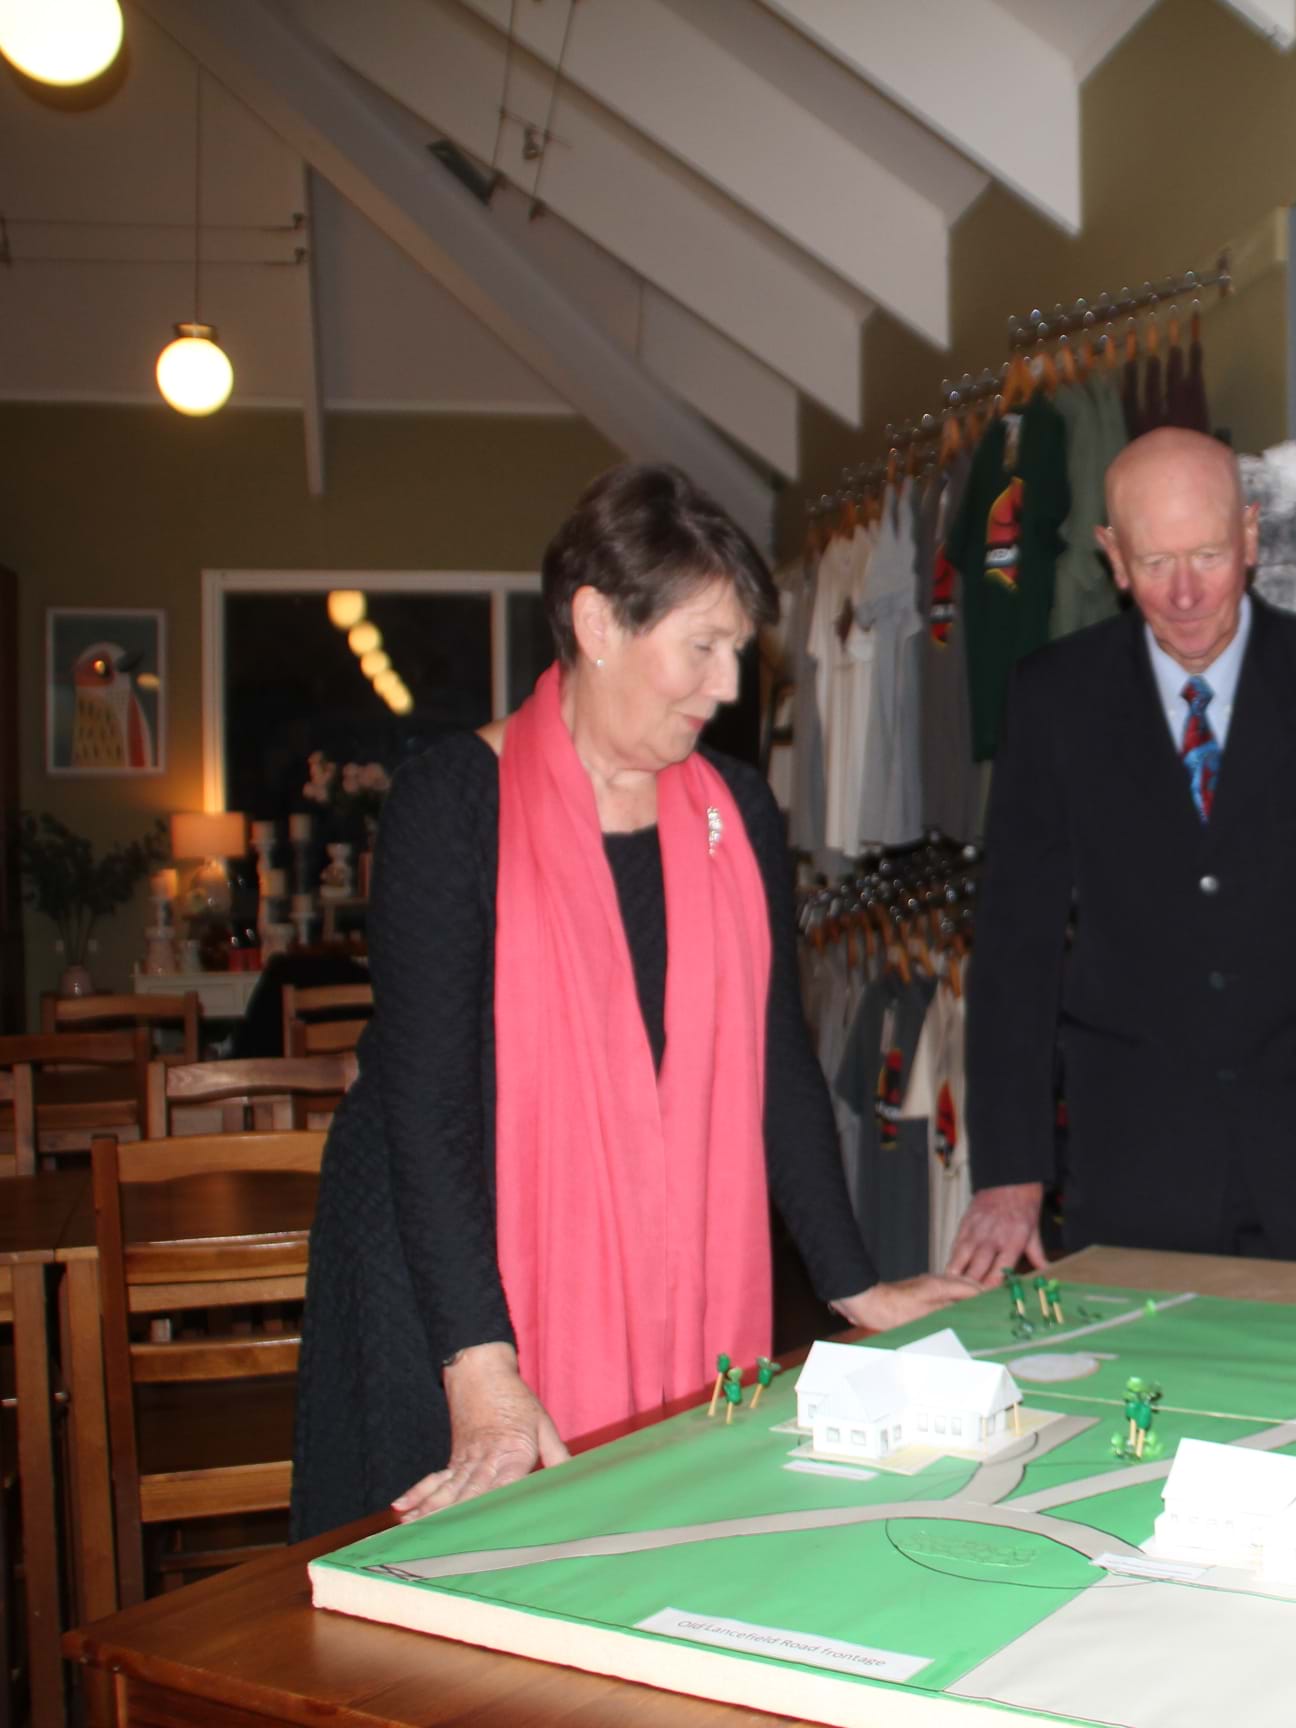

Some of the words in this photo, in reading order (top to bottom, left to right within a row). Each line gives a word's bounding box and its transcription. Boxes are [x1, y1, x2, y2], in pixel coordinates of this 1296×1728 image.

[677, 1620, 708, 1630] Old
[704, 1623, 780, 1644] Lancefield
[780, 1639, 821, 1652] Road
[820, 1647, 886, 1666] frontage
